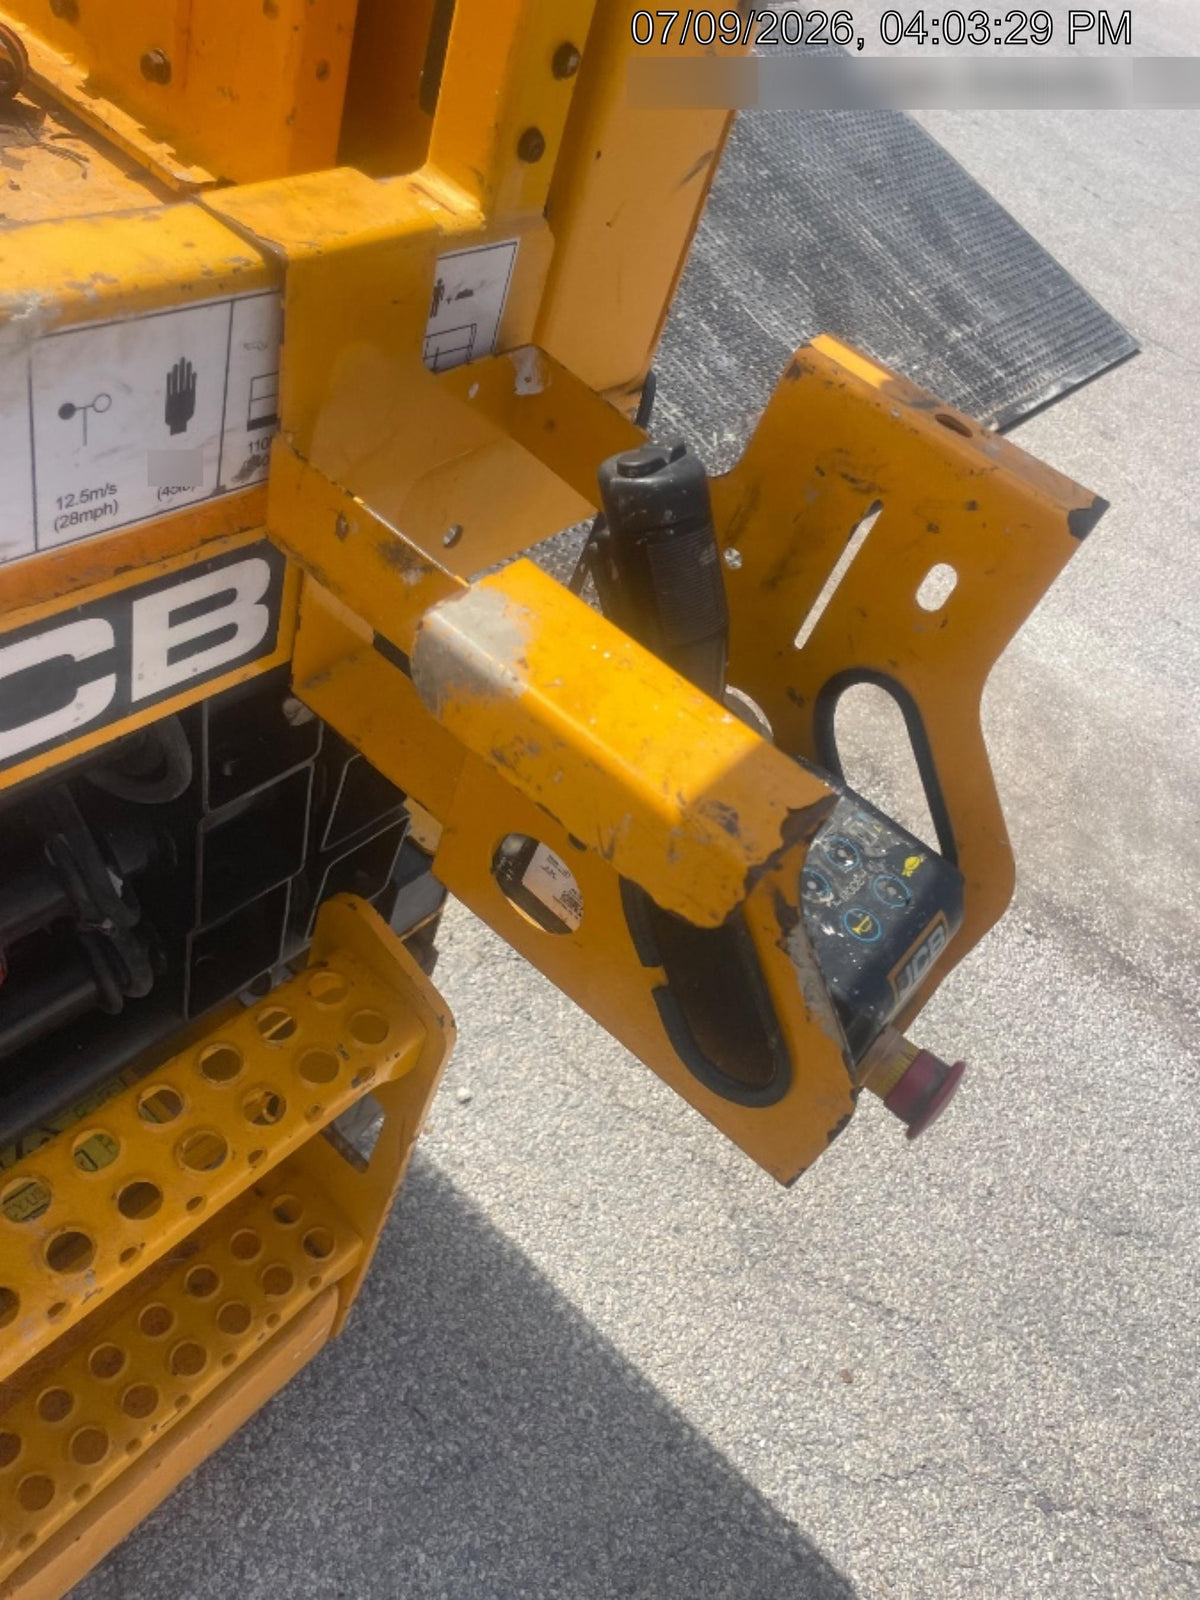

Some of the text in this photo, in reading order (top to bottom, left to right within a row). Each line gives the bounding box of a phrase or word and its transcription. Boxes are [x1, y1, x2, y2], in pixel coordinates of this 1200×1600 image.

[56, 483, 118, 511] 12.5m/s
[54, 498, 119, 534] (28mph)
[897, 925, 945, 995] JCB
